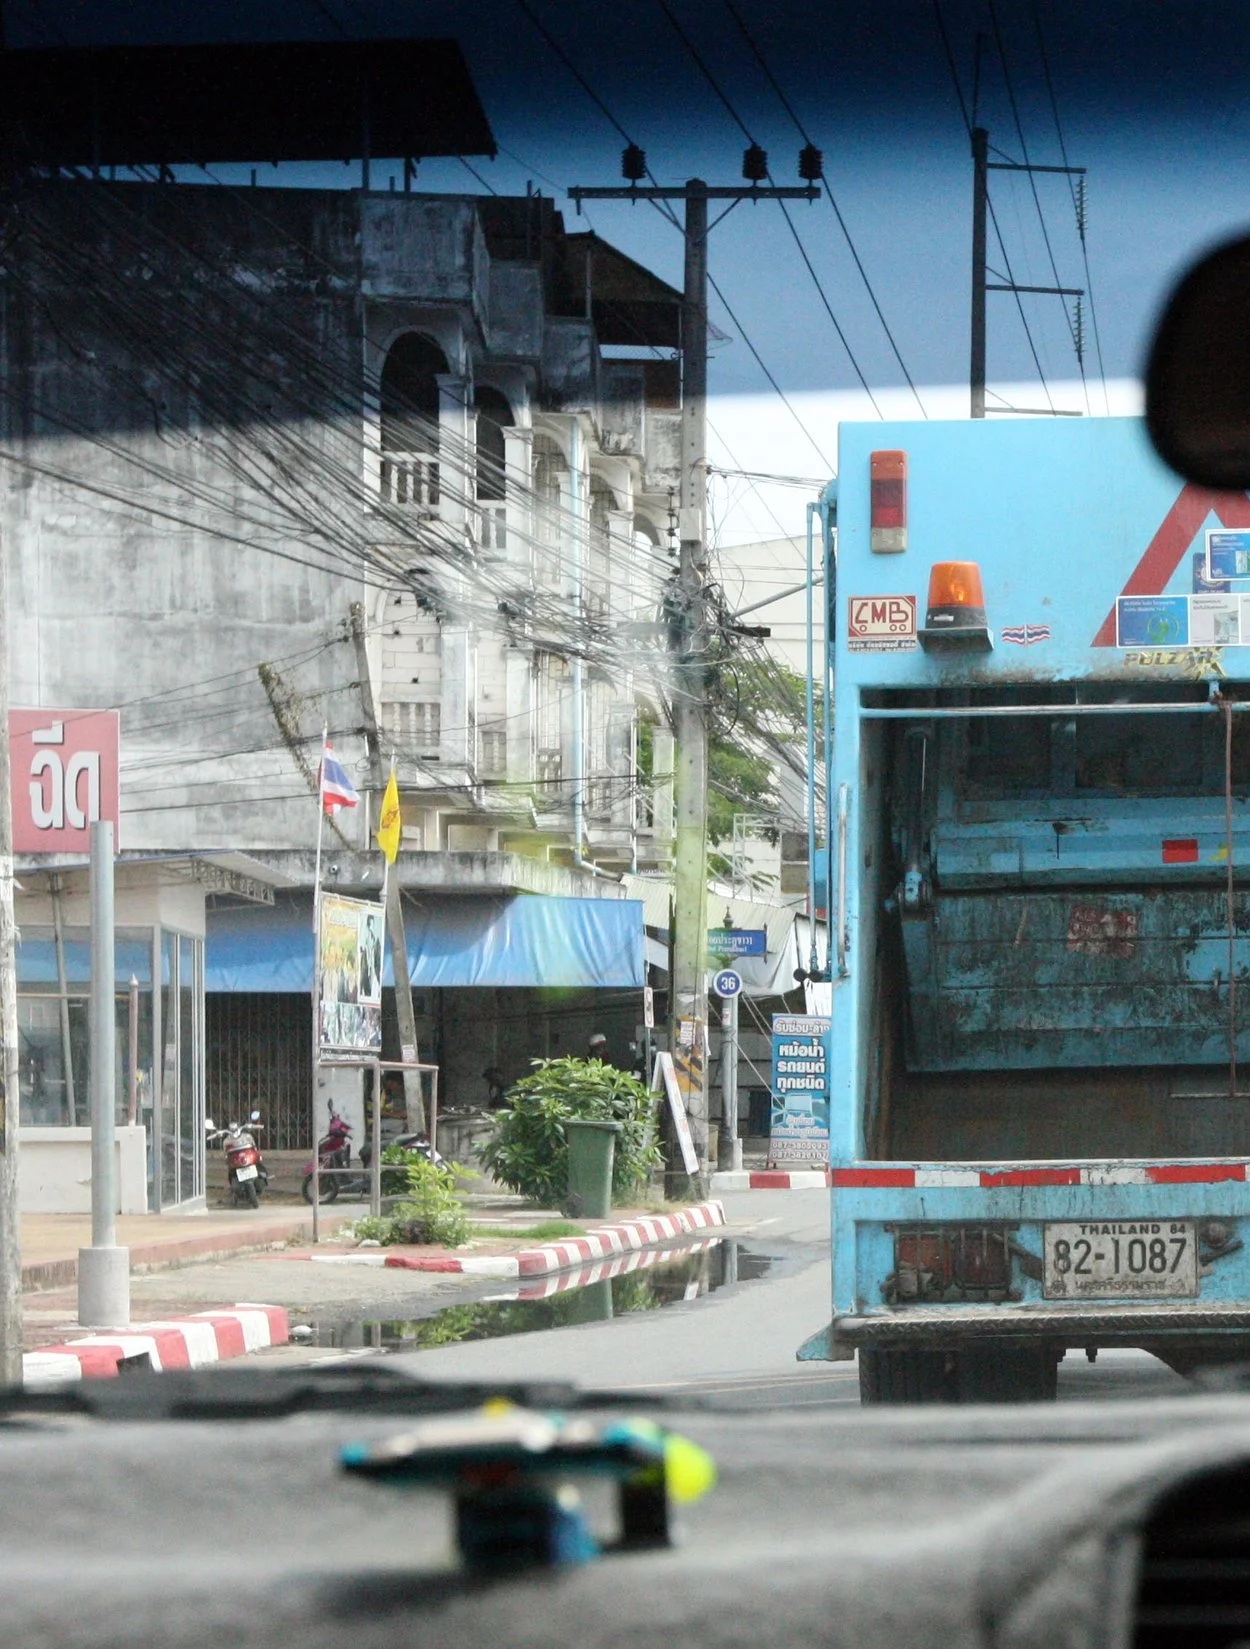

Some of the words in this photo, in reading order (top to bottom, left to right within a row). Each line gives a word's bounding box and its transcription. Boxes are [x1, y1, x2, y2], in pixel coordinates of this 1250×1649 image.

[855, 602, 909, 624] CMB
[1125, 650, 1214, 667] PULZAR
[721, 977, 736, 991] 36
[779, 1038, 824, 1057] หม้อน้ำ
[777, 1058, 826, 1073] รถยนต์
[777, 1075, 825, 1093] ทุกชนิด
[1080, 1224, 1160, 1235] THAILAND
[1170, 1224, 1186, 1234] 84
[1054, 1238, 1187, 1274] 82-1087
